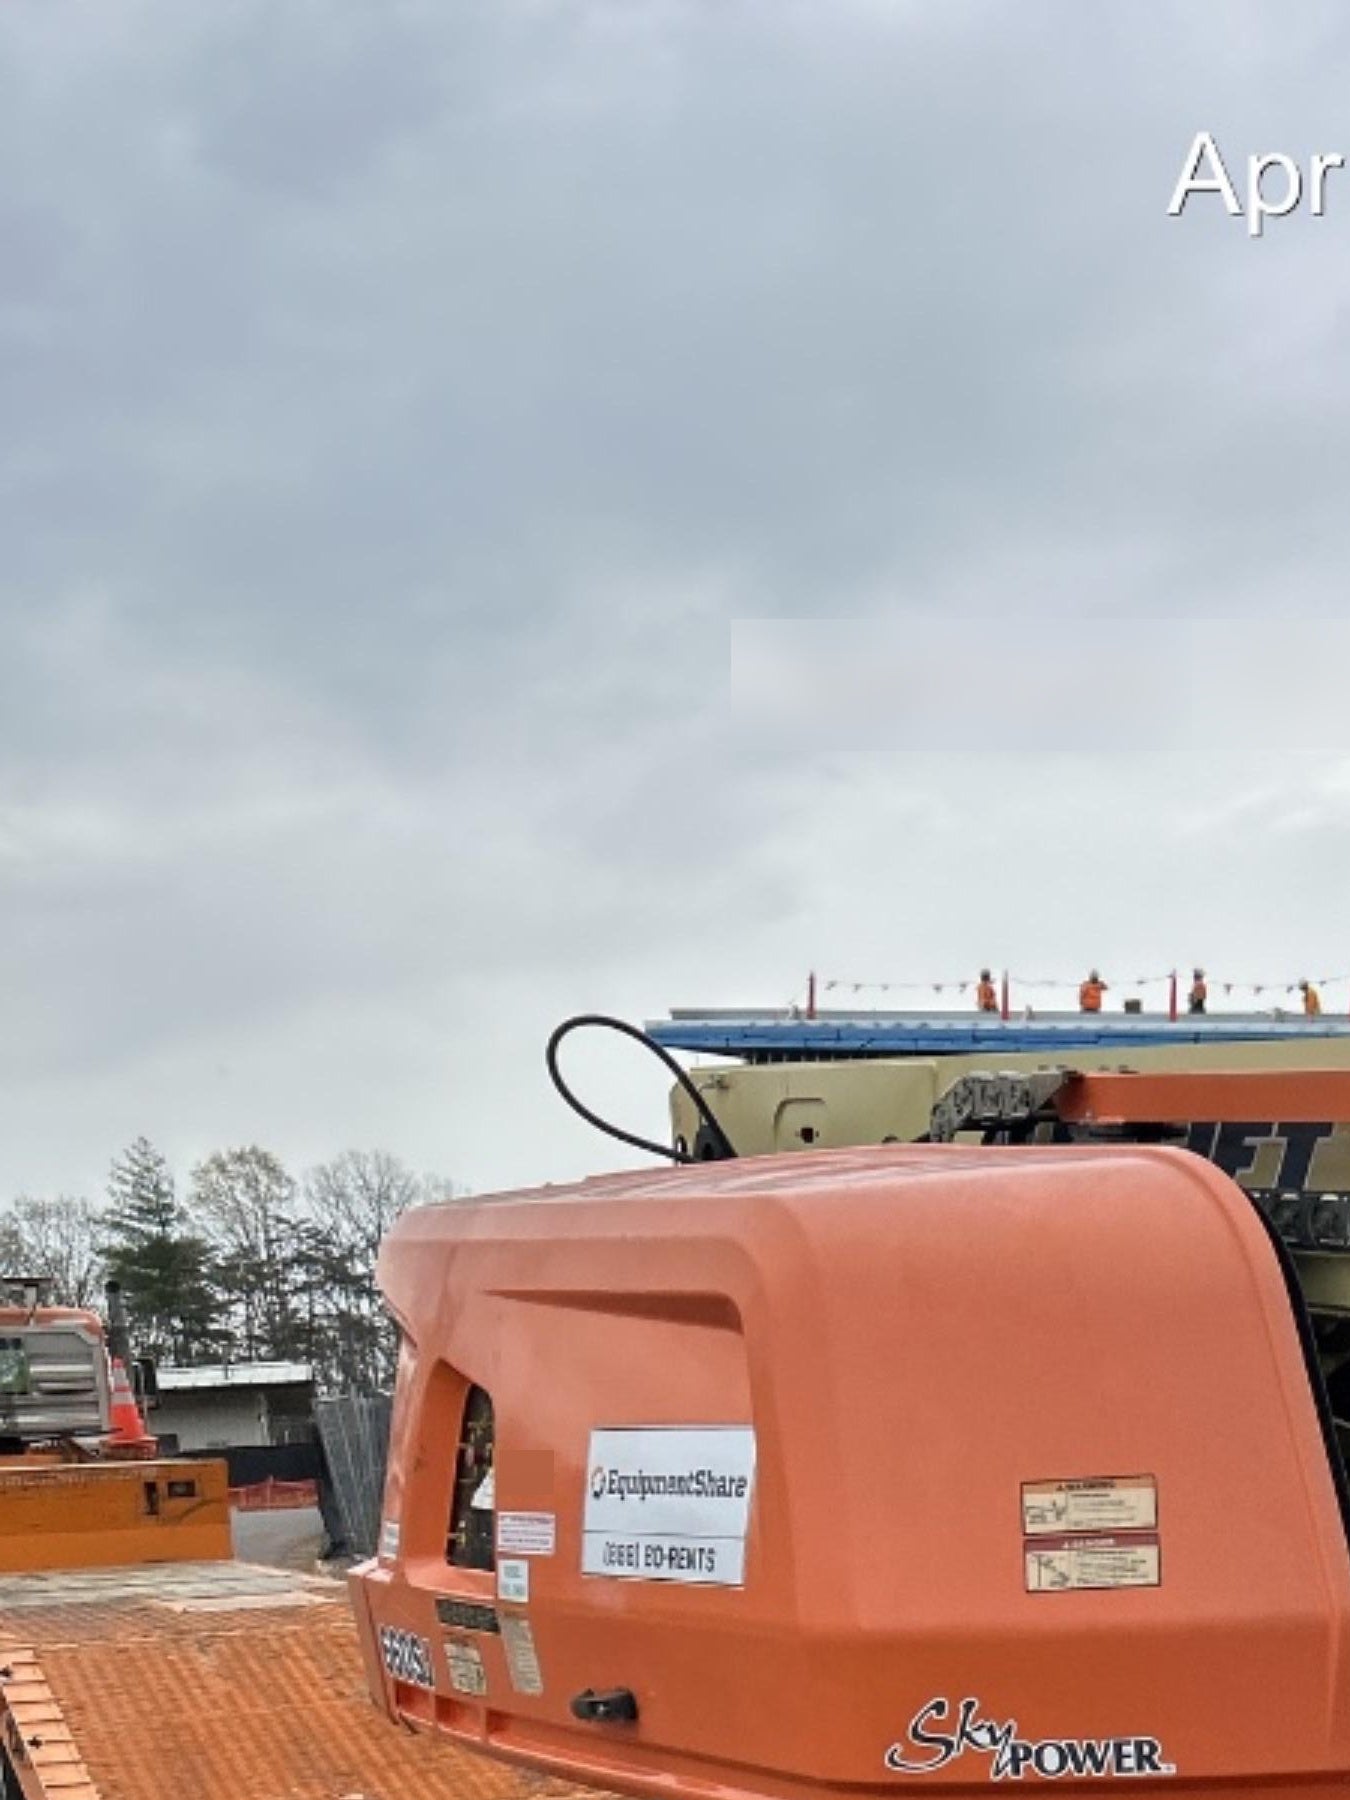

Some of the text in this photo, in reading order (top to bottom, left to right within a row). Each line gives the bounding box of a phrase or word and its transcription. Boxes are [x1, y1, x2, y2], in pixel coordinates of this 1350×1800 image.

[606, 1469, 748, 1501] EquipmentShare
[885, 1698, 1168, 1781] Sky POWER
